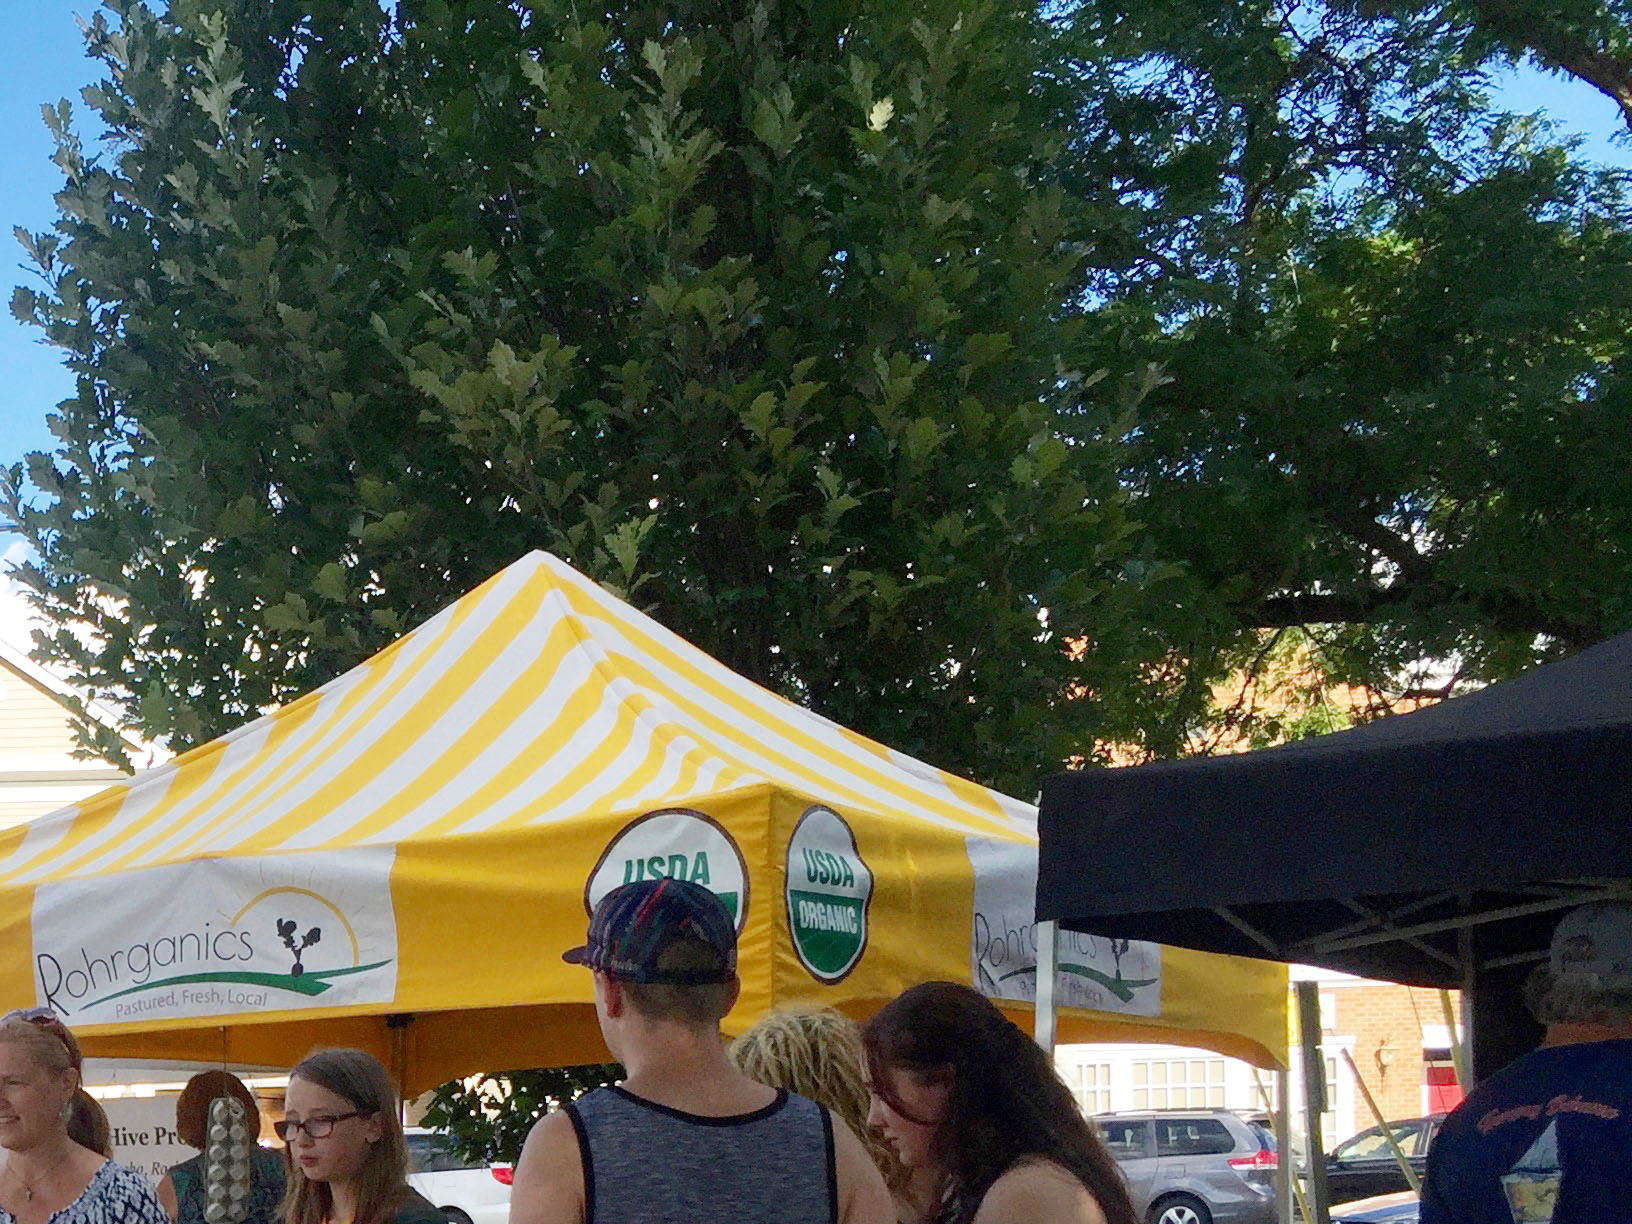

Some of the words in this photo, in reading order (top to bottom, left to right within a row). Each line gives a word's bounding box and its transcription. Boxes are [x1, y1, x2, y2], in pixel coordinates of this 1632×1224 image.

[623, 851, 711, 885] USDA
[802, 848, 855, 888] USDA
[799, 900, 858, 934] ORGANIC
[37, 923, 254, 1016] Rohrganics
[116, 991, 180, 1018] Pastured,
[182, 988, 225, 1006] Fresh,
[228, 989, 268, 1007] Local
